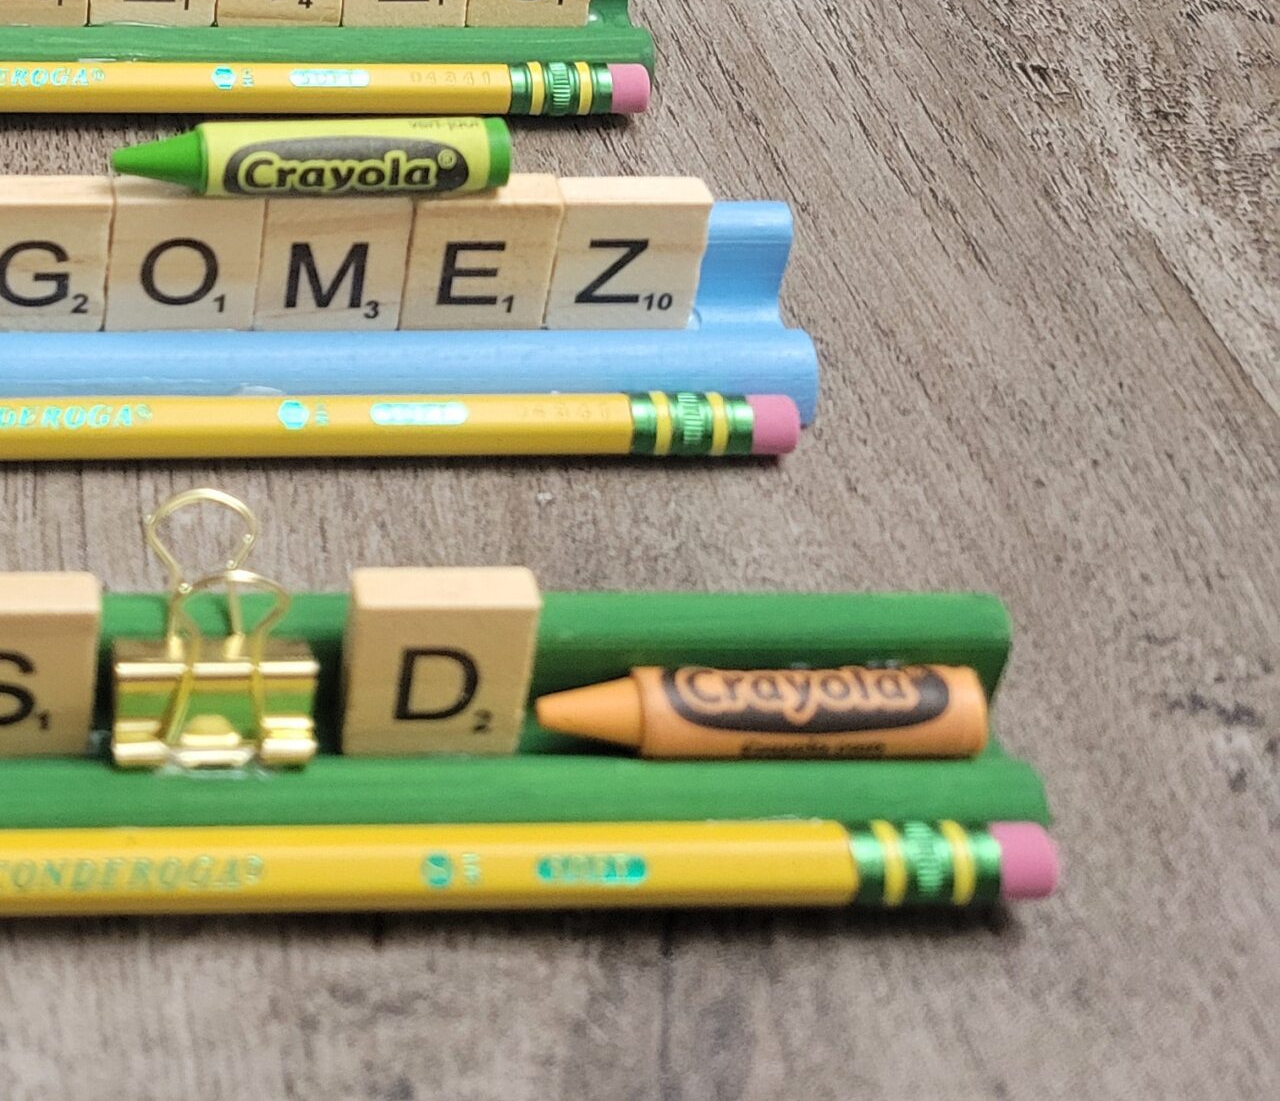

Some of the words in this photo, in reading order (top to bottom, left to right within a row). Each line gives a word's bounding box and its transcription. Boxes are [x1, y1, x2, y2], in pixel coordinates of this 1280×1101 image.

[240, 150, 438, 193] Crayola
[392, 647, 481, 723] D
[684, 668, 912, 720] Crayola
